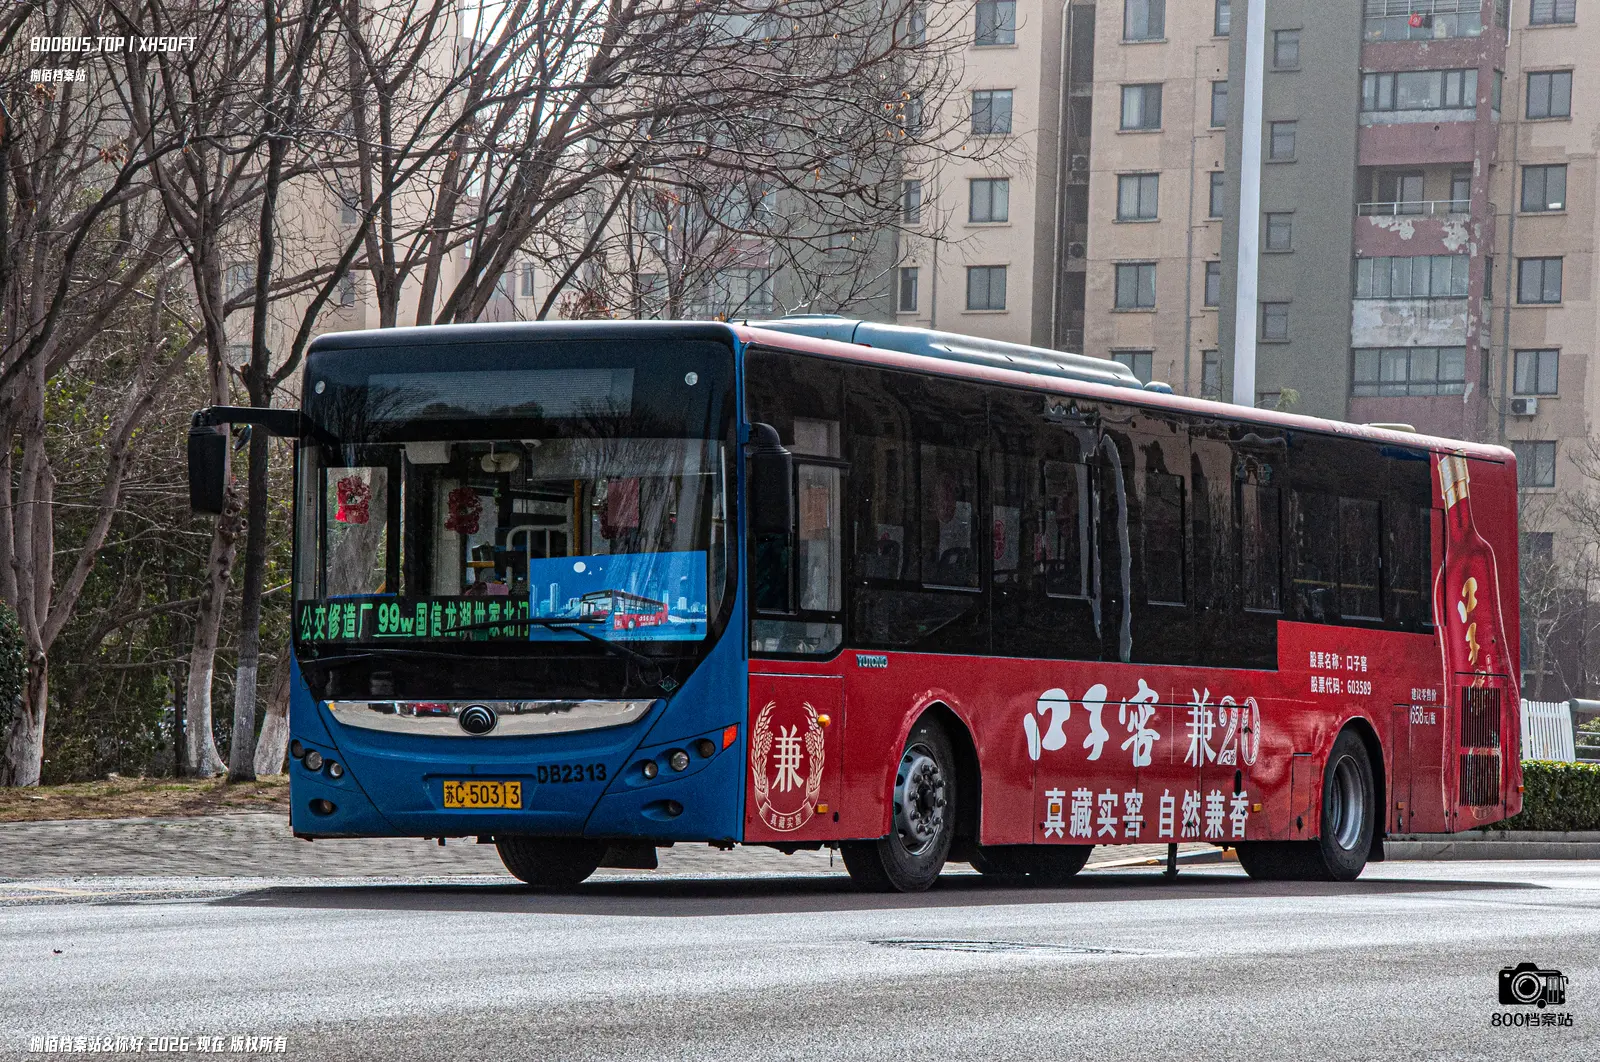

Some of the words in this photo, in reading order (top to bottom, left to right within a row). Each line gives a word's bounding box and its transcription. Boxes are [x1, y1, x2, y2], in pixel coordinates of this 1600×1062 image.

[301, 604, 374, 640] 公交修造厂
[856, 654, 888, 668] YUTONG
[1347, 680, 1372, 695] 603589
[771, 724, 804, 792] 兼
[537, 764, 607, 784] DB2313
[1044, 787, 1144, 839] 真藏实窖
[1158, 788, 1249, 839] 自然兼香
